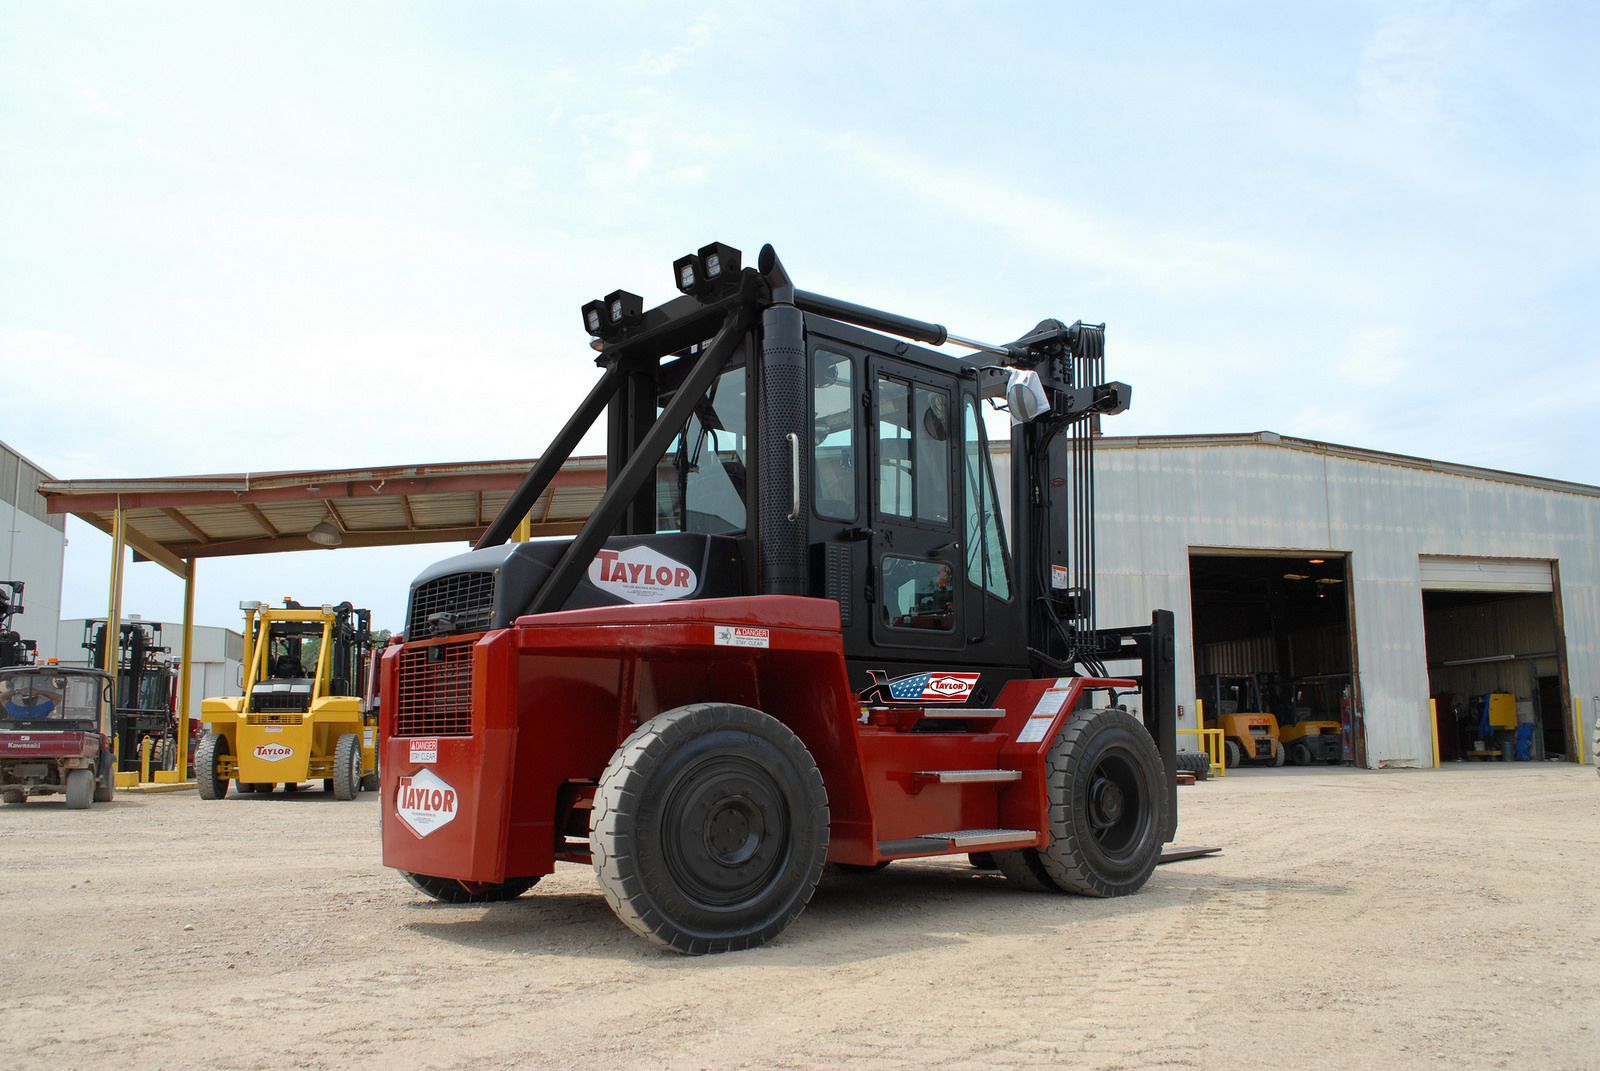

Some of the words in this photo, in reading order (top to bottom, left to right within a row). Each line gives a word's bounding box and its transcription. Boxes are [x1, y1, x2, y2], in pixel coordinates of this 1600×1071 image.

[595, 550, 691, 588] TAYLOR
[742, 628, 767, 638] DANGER
[934, 680, 964, 690] TAYLOR
[256, 746, 291, 755] TAYLOR
[415, 741, 437, 750] DANGER
[420, 752, 436, 761] CLEAR
[400, 778, 455, 813] TAYLOR
